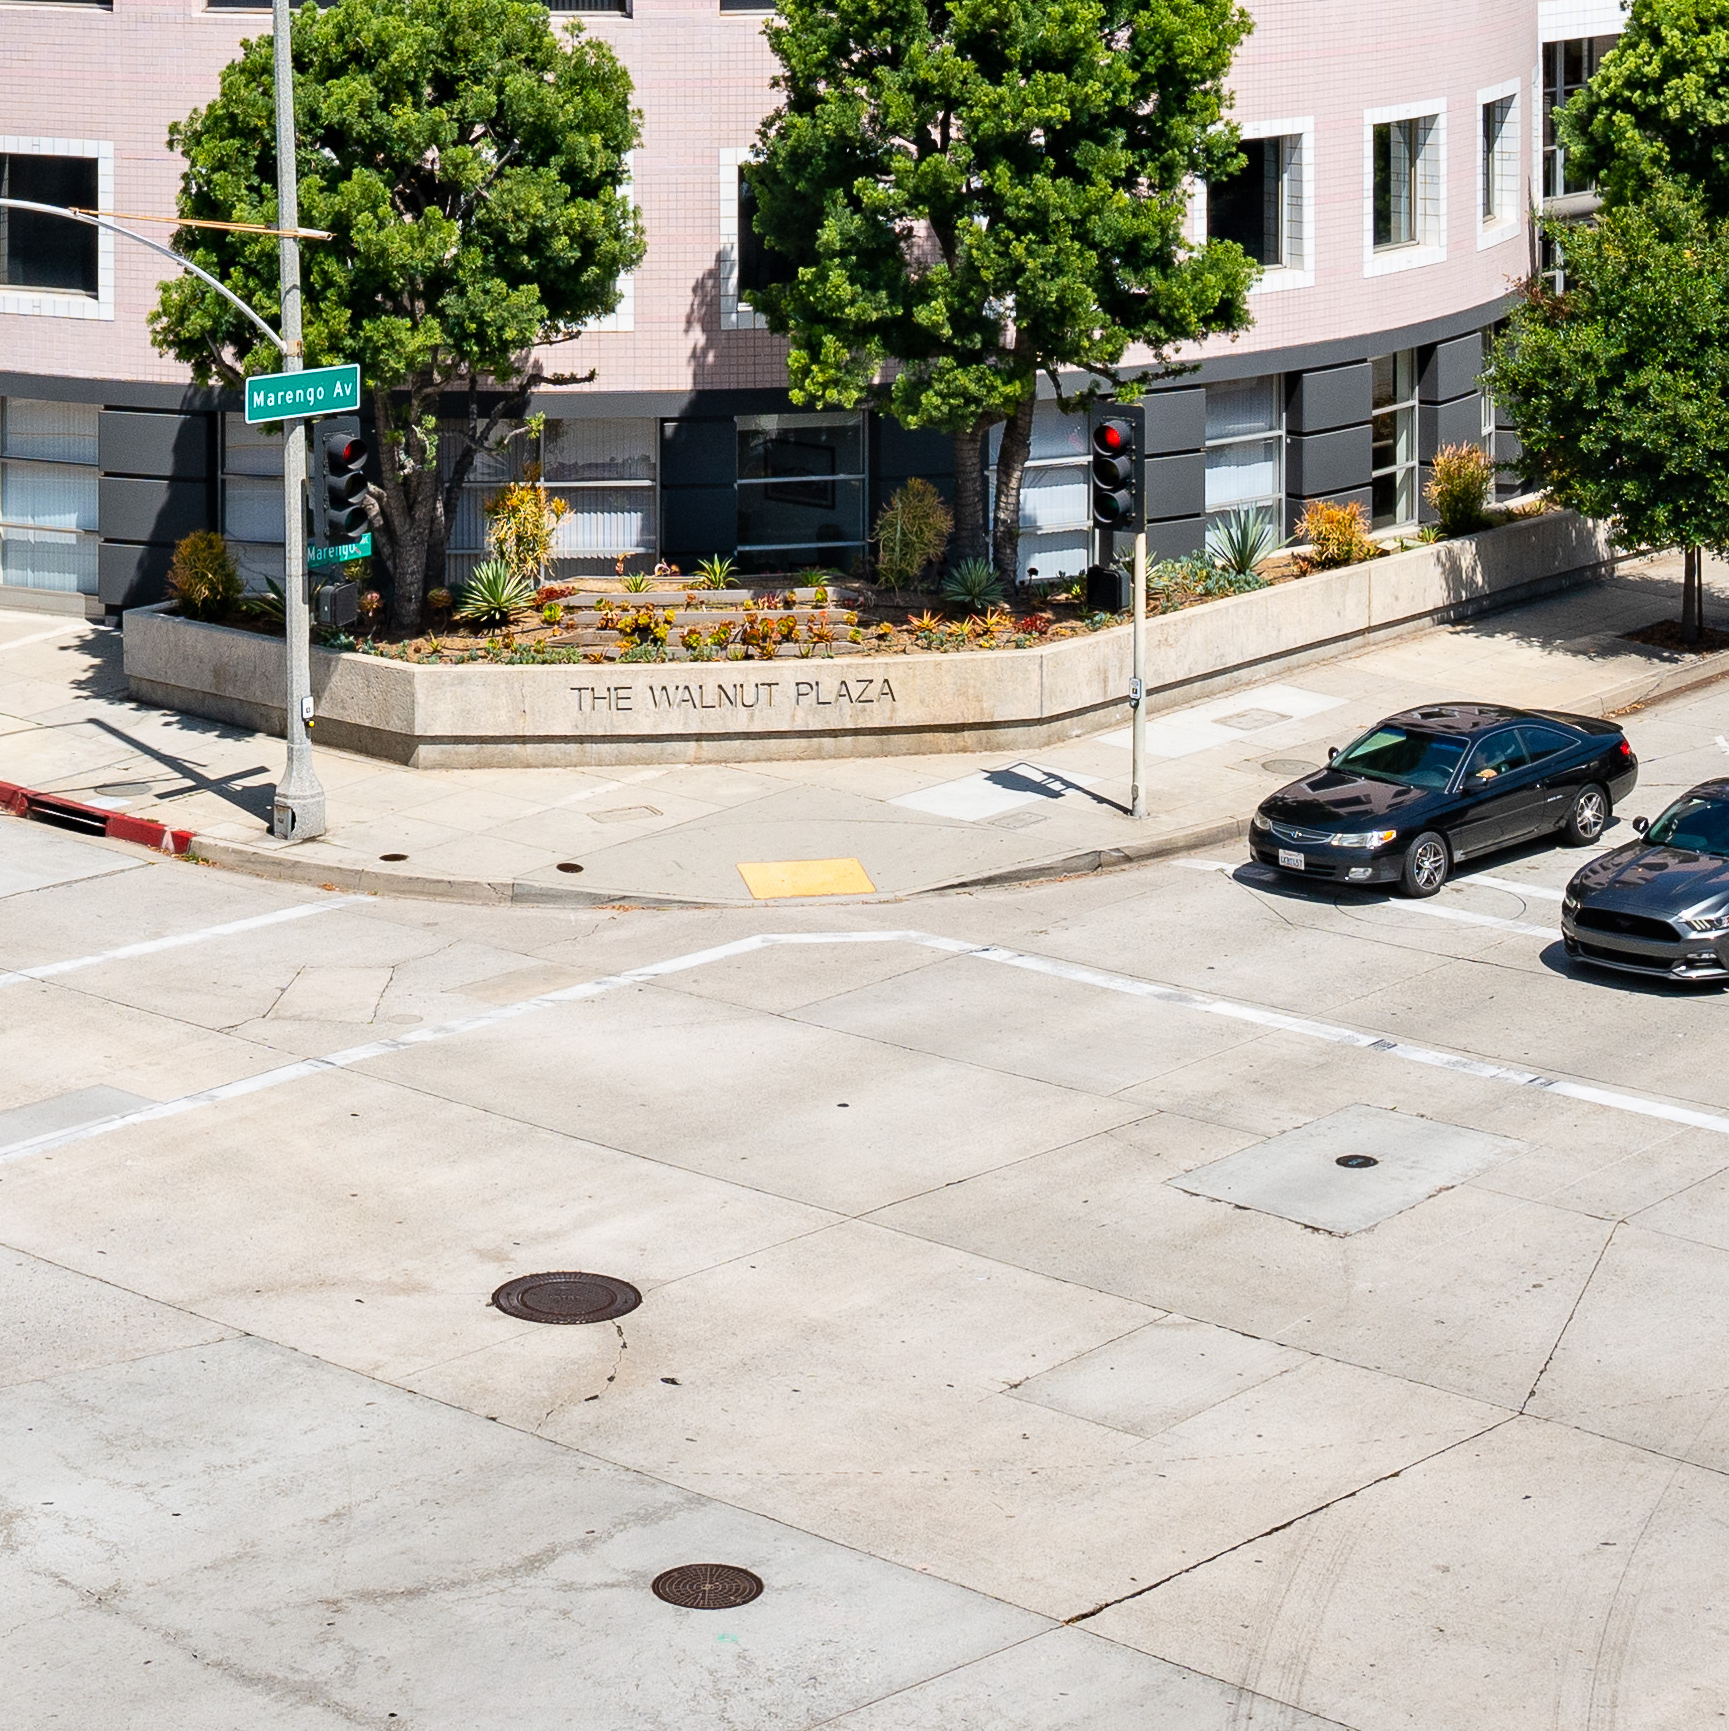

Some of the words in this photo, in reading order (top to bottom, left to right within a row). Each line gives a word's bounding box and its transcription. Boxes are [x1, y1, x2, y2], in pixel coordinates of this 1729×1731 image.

[252, 385, 325, 408] Marengo
[333, 380, 353, 398] Av
[307, 543, 356, 562] Marengo
[570, 686, 633, 713] THE
[649, 681, 780, 710] WALNUT
[796, 678, 897, 706] PLAZA
